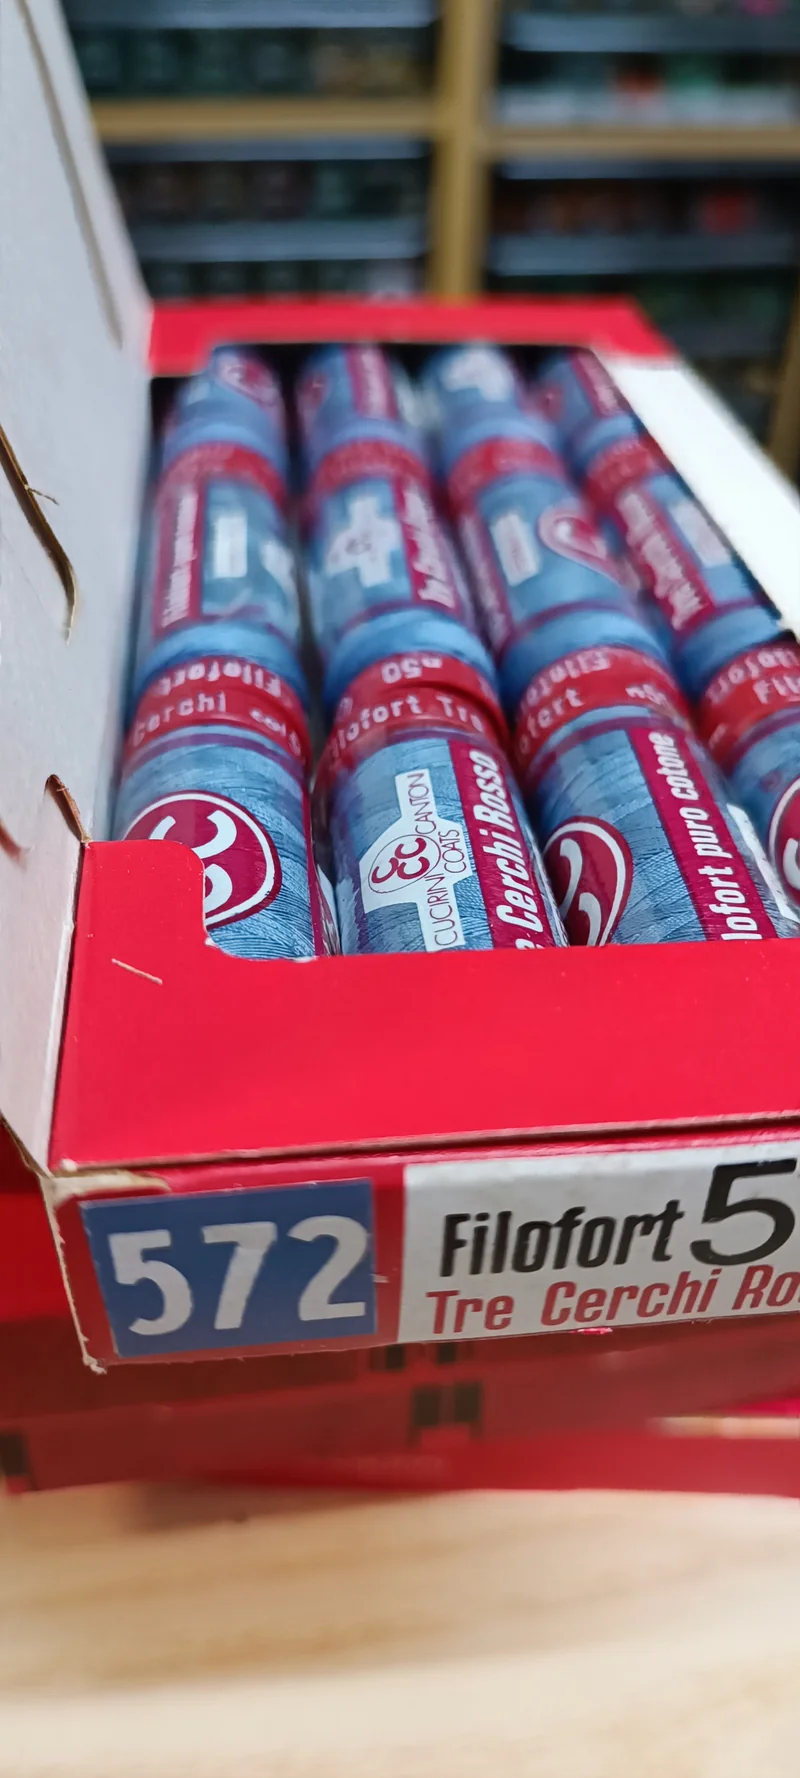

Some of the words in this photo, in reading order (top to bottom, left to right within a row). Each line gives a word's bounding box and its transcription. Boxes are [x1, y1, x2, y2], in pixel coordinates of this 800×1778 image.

[469, 750, 516, 833] Rosso
[648, 731, 700, 801] cotone
[437, 829, 467, 874] COATS
[679, 807, 734, 859] puro
[425, 872, 458, 946] CUCIRINI
[479, 828, 544, 933] Cerchi
[440, 1199, 685, 1278] Filofort
[689, 1158, 800, 1266] 5
[107, 1215, 368, 1336] 572
[425, 1290, 514, 1335] Tre
[540, 1268, 722, 1327] Cerchi
[731, 1264, 800, 1311] Ro
